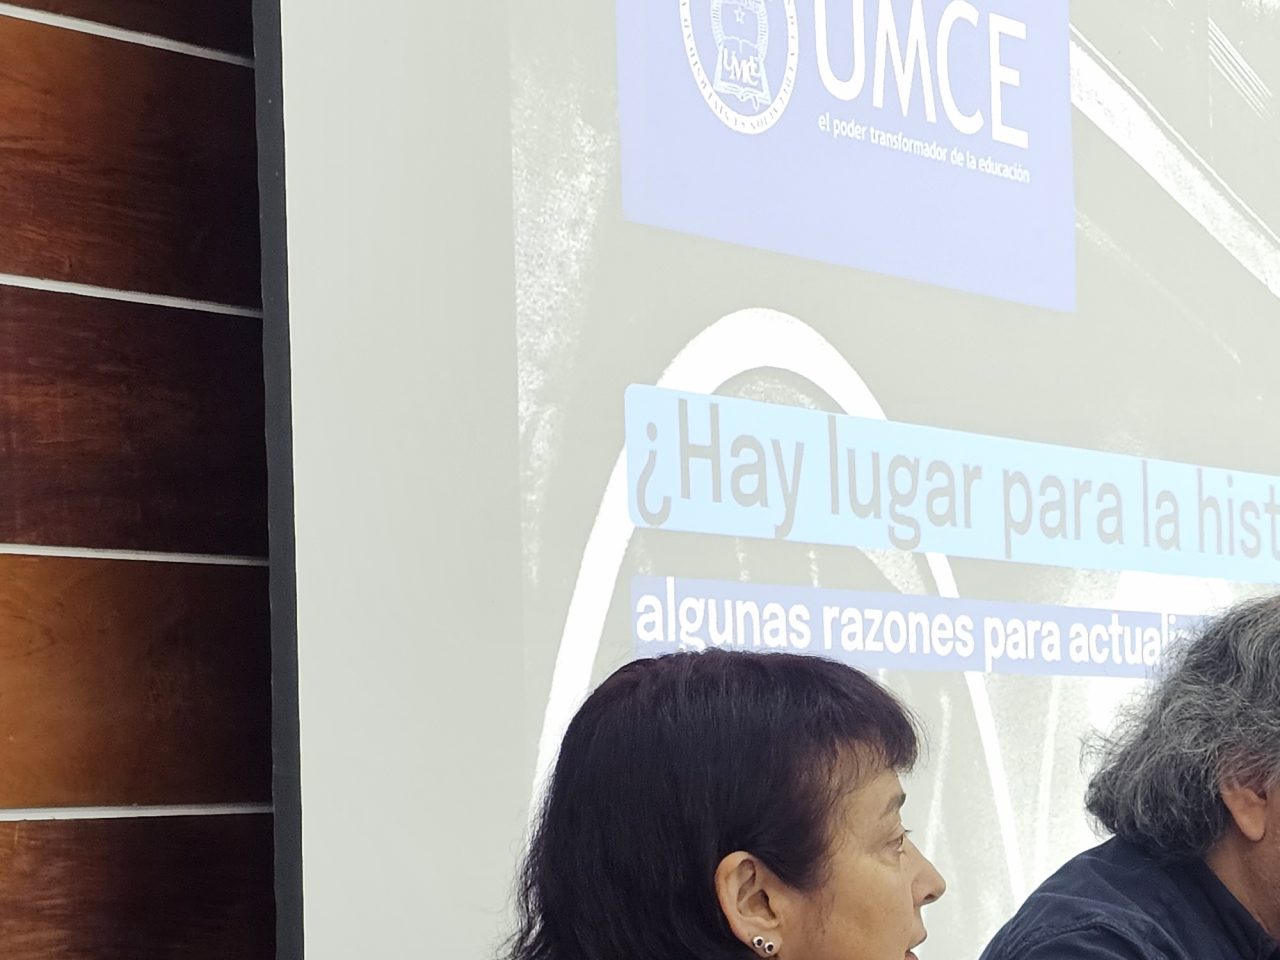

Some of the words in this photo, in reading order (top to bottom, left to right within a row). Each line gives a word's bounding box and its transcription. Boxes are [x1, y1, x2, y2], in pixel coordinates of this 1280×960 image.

[814, 0, 1029, 149] UMCE
[818, 113, 831, 131] el
[832, 117, 867, 142] poder
[870, 126, 947, 162] transformador
[950, 148, 965, 166] de
[966, 151, 978, 170] la
[978, 156, 1030, 183] educación
[636, 398, 805, 539] ¿Hay
[827, 414, 983, 551] lugar
[1002, 467, 1124, 560] para
[1141, 459, 1183, 551] la
[636, 576, 811, 652] algunas
[823, 603, 975, 657] razones
[984, 616, 1061, 673] para
